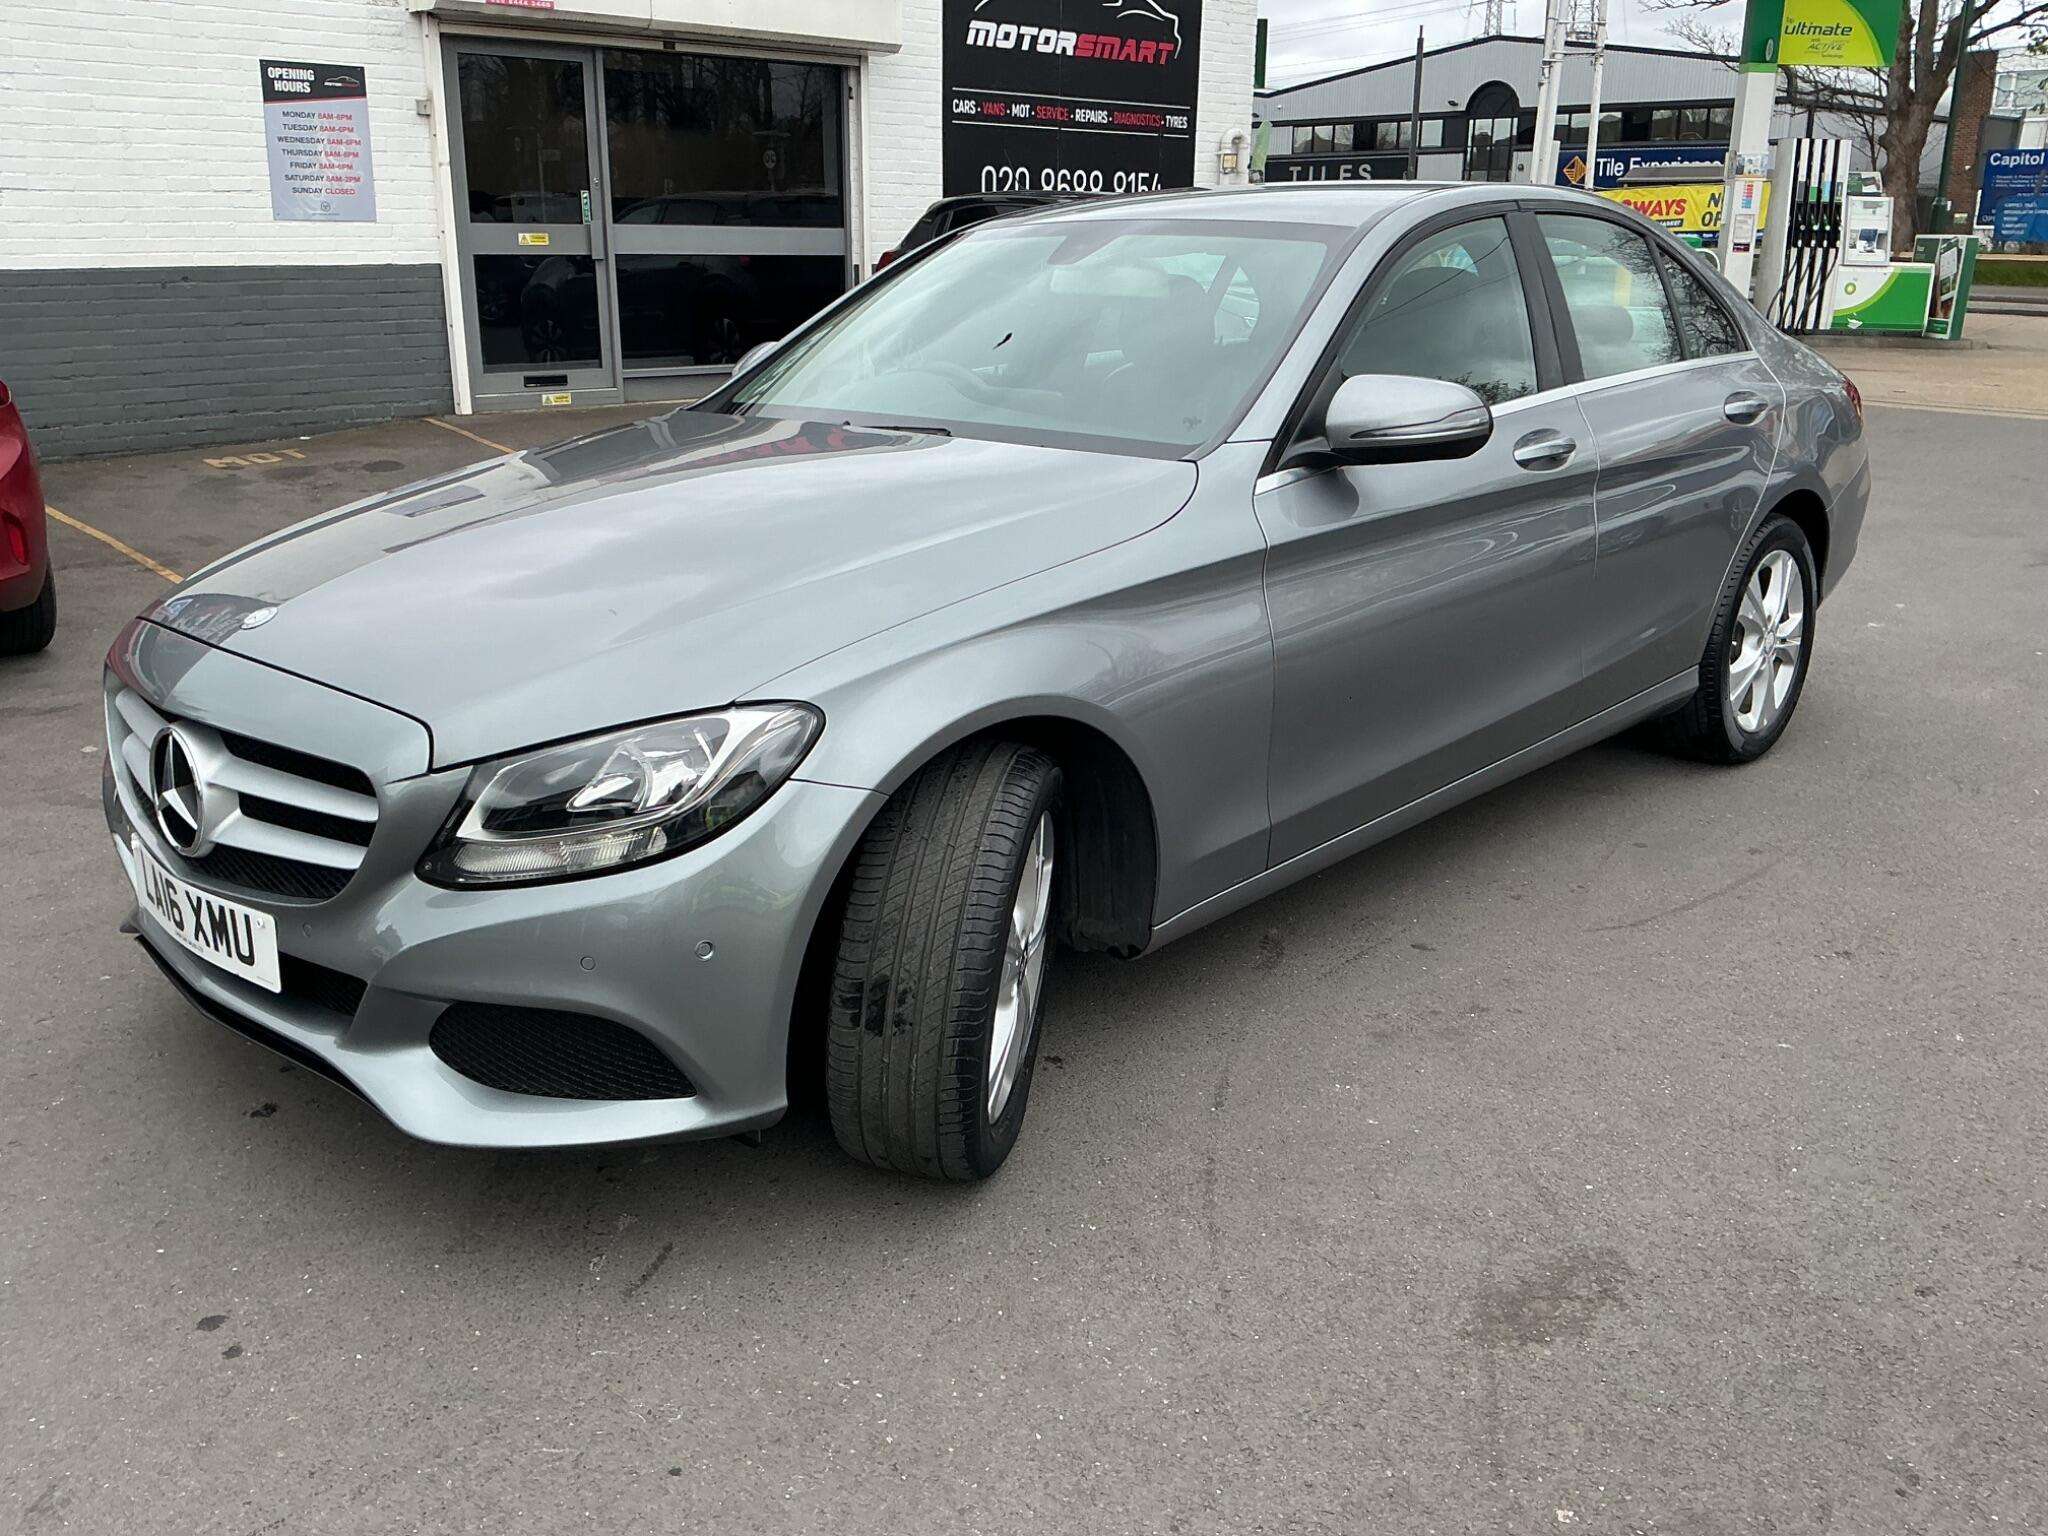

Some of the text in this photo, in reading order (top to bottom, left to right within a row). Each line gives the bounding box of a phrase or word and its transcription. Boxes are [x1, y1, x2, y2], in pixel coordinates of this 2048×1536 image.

[1784, 21, 1853, 36] ultimate
[966, 19, 1175, 65] MOTORSMART
[267, 66, 315, 81] OPENING
[273, 80, 311, 93] HOURS
[282, 110, 316, 120] MONDAY
[952, 99, 1188, 129] CARS VANS MOT SERVICE REPAIRS DIAGNOSTICS TYRES
[282, 123, 318, 133] TUESDAY
[277, 135, 325, 145] WEDNESDAY
[281, 148, 323, 158] THURSDAY
[1990, 151, 2045, 169] Capitol
[289, 161, 317, 170] FRIDAY
[1597, 157, 1624, 177] Tile
[284, 174, 325, 182] SATURDAY
[291, 186, 356, 196] SUNDAY CLOSED
[203, 448, 306, 468] MOT
[140, 848, 256, 967] LA16 XMU
